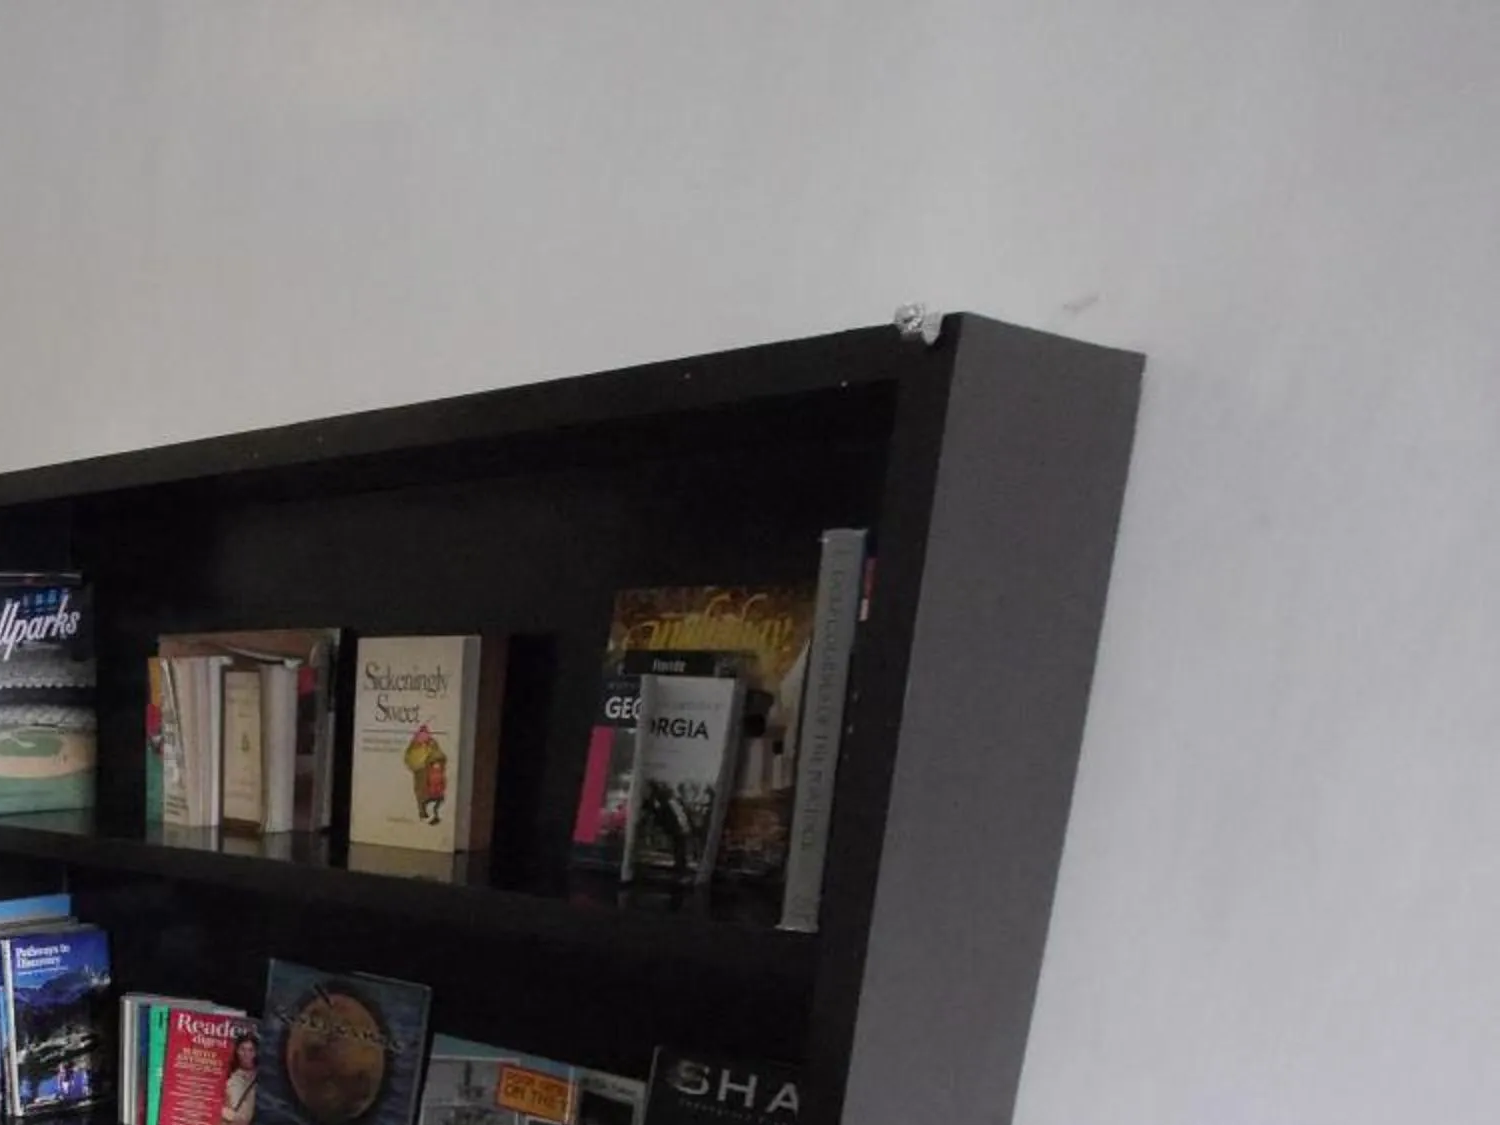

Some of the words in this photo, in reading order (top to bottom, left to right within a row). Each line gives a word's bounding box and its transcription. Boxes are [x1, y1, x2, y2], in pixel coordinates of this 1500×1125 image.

[363, 661, 451, 698] Sickeningly
[375, 693, 421, 724] Sweet
[650, 717, 710, 740] RGIA
